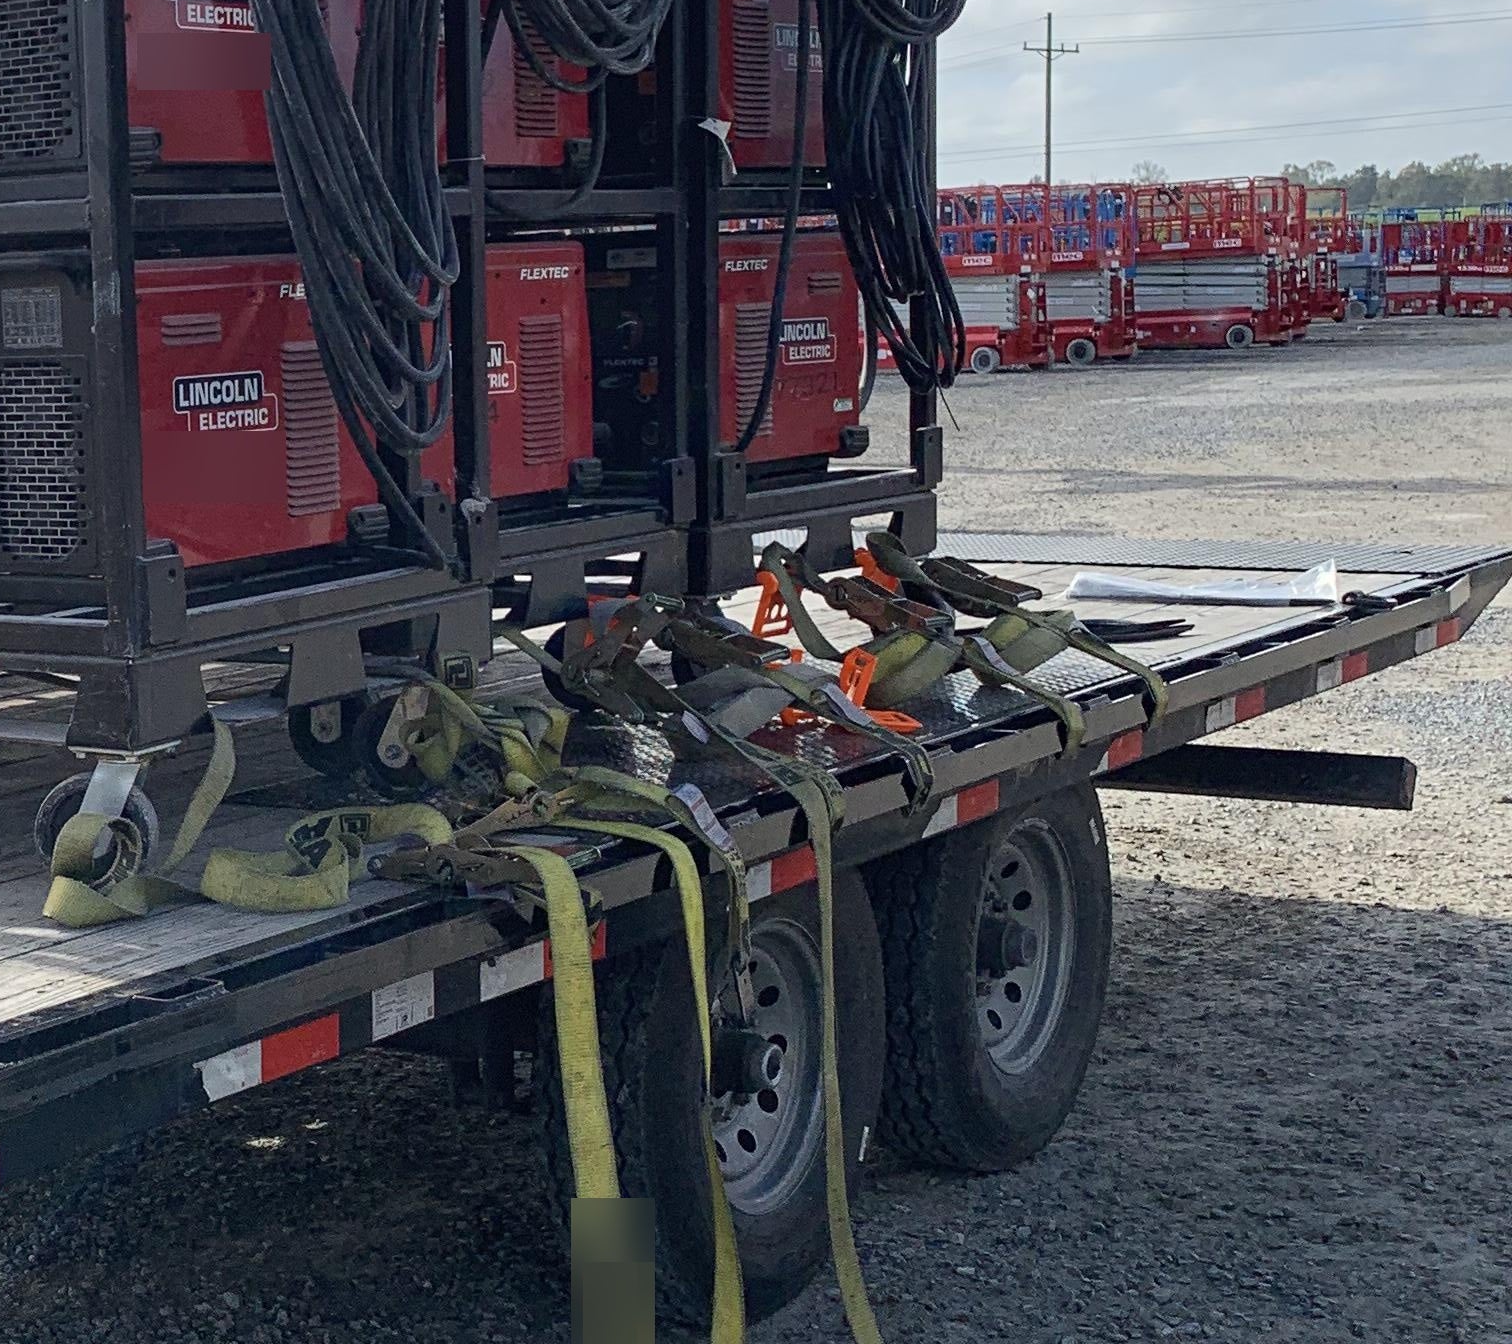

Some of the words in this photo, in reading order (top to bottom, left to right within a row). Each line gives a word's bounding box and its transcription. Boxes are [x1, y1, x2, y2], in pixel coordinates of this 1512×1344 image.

[519, 265, 570, 281] FLEXTEC
[724, 258, 769, 273] FLEXTEC
[780, 323, 826, 342] INCOLN
[789, 345, 831, 361] ELECTRIC
[178, 377, 259, 408] LINCOLN
[198, 407, 270, 432] ELECTRIC
